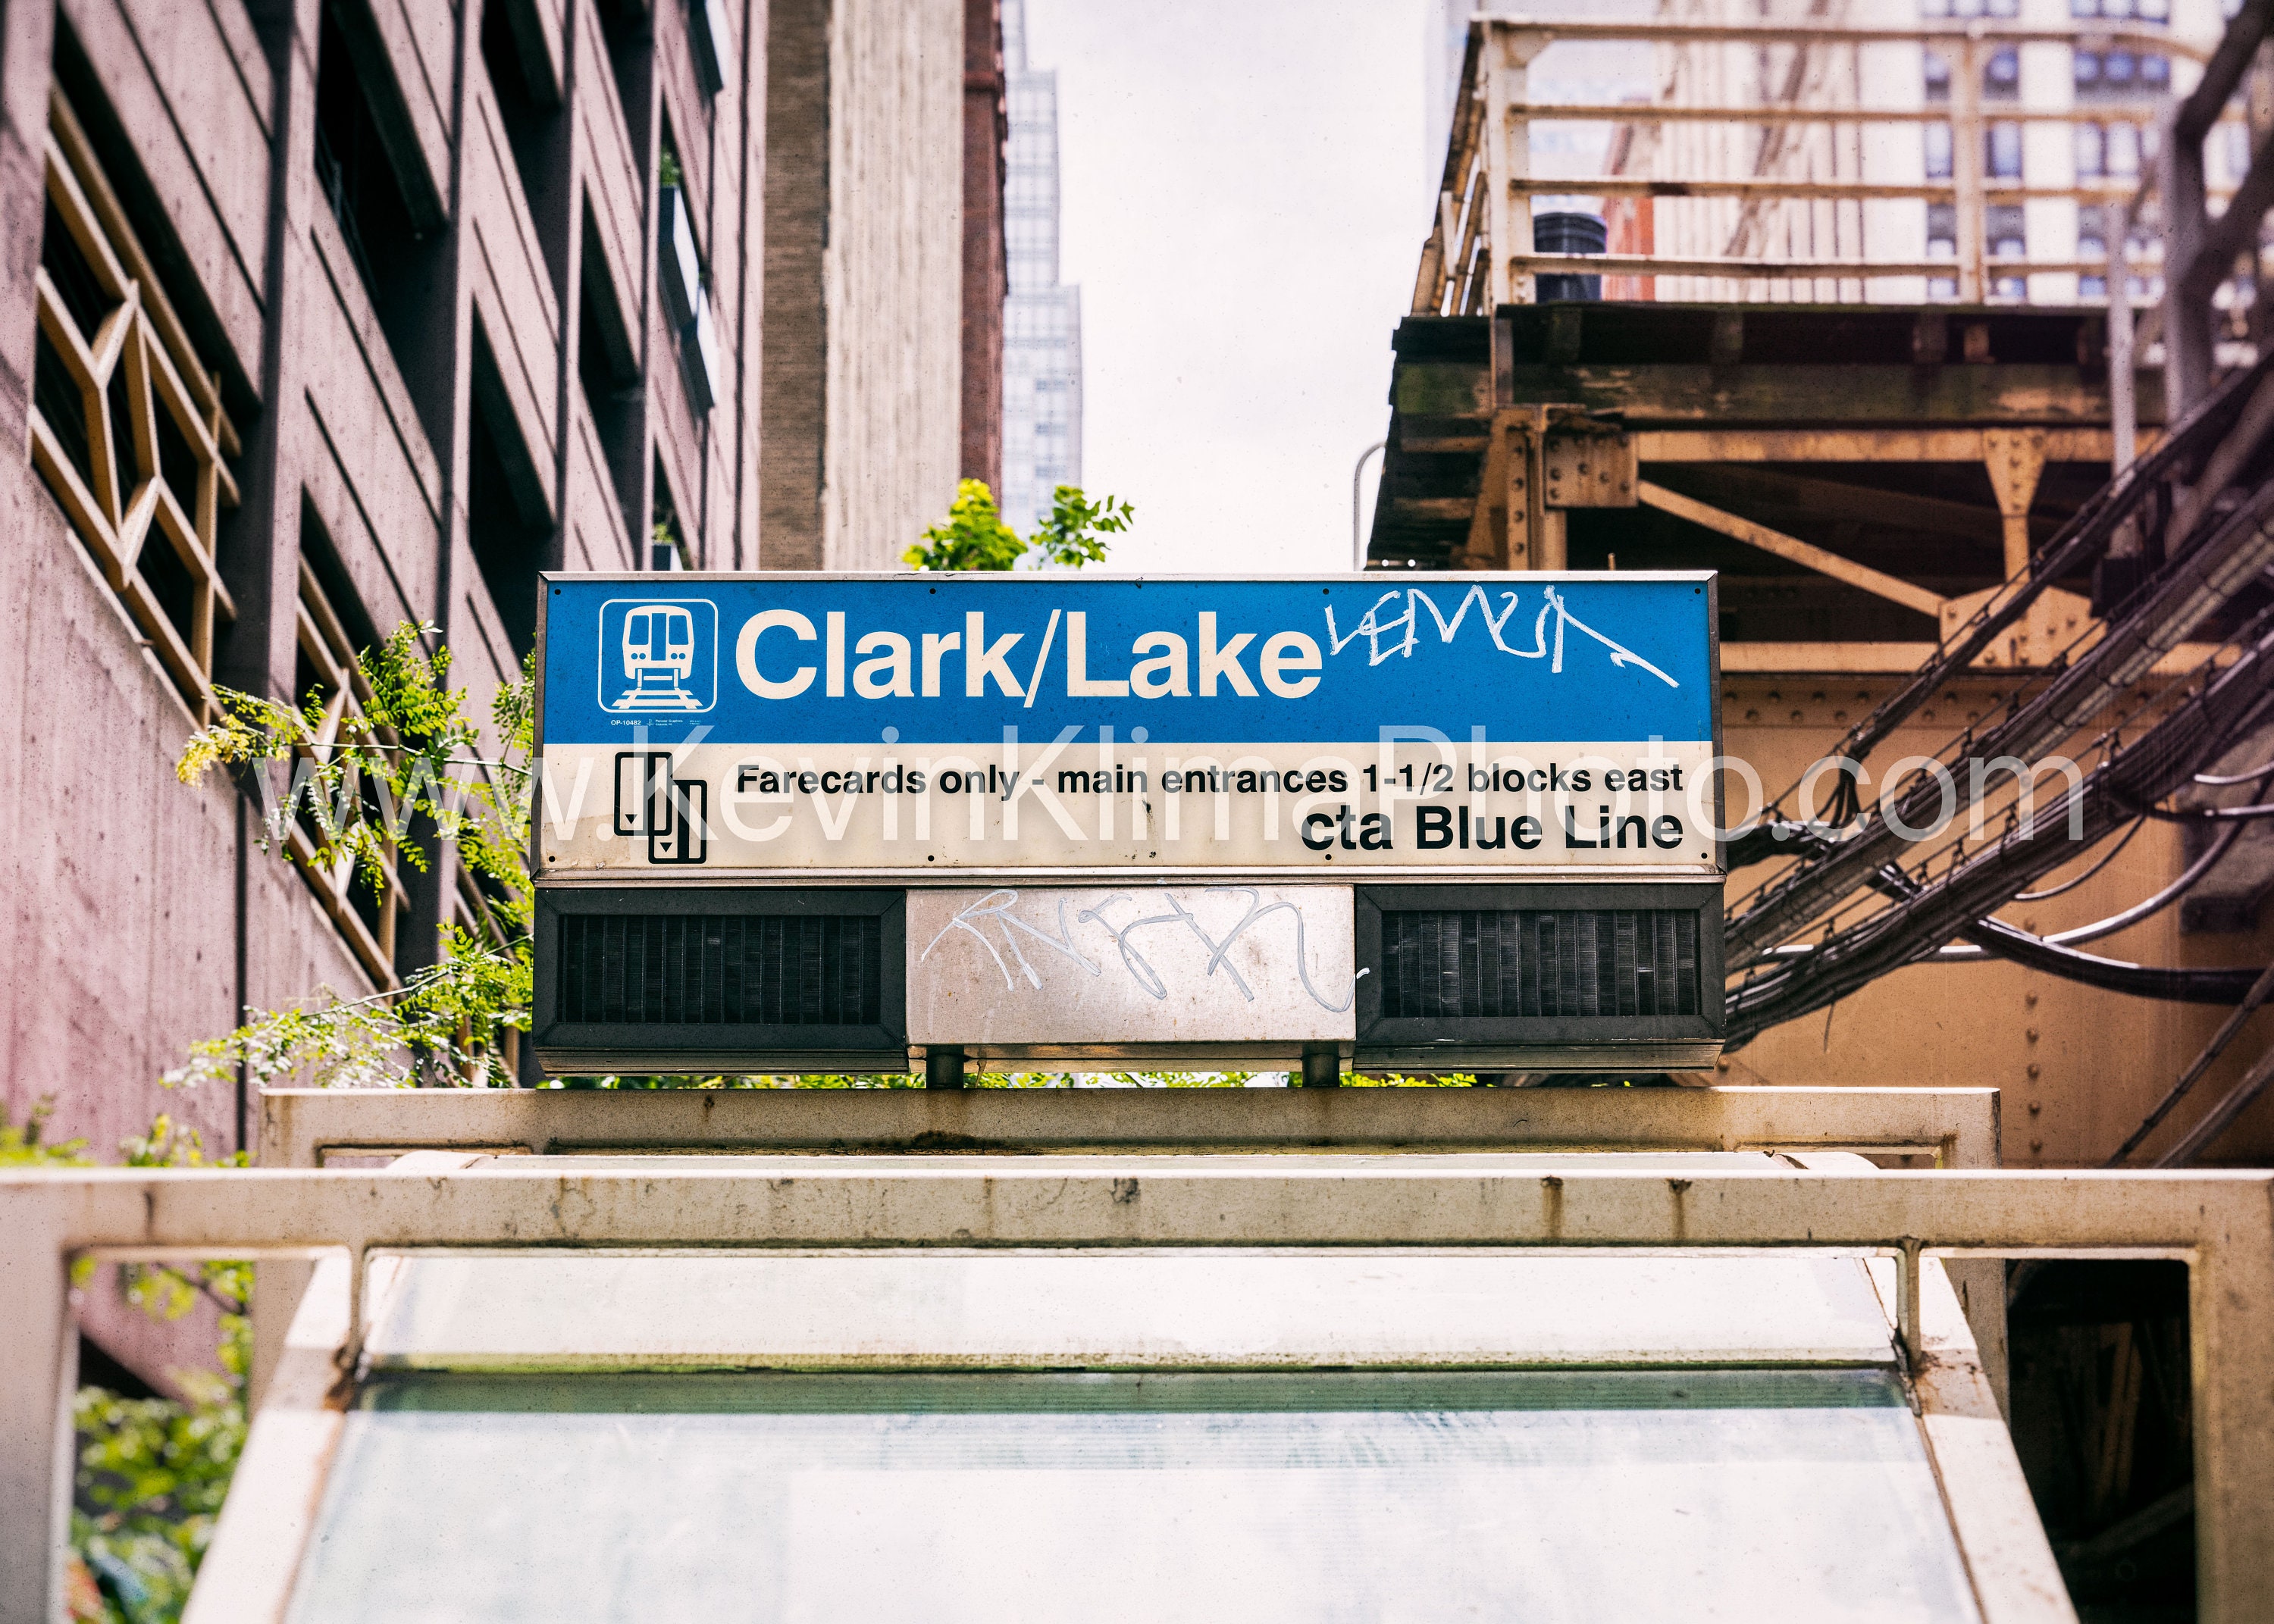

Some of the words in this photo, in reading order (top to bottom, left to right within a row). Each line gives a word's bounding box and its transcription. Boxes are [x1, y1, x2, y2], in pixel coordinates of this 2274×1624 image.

[735, 609, 1323, 708] Clark/Lake
[738, 764, 926, 794] Farecards
[939, 764, 1020, 801] only
[1059, 764, 1148, 793] main
[1161, 765, 1348, 793] entrances
[1363, 763, 1454, 796] 1-1/2
[1468, 763, 1592, 793] blocks
[1604, 767, 1684, 793] east
[1301, 805, 1394, 851] cta
[1416, 805, 1543, 850] Blue
[1565, 805, 1684, 850] Line
